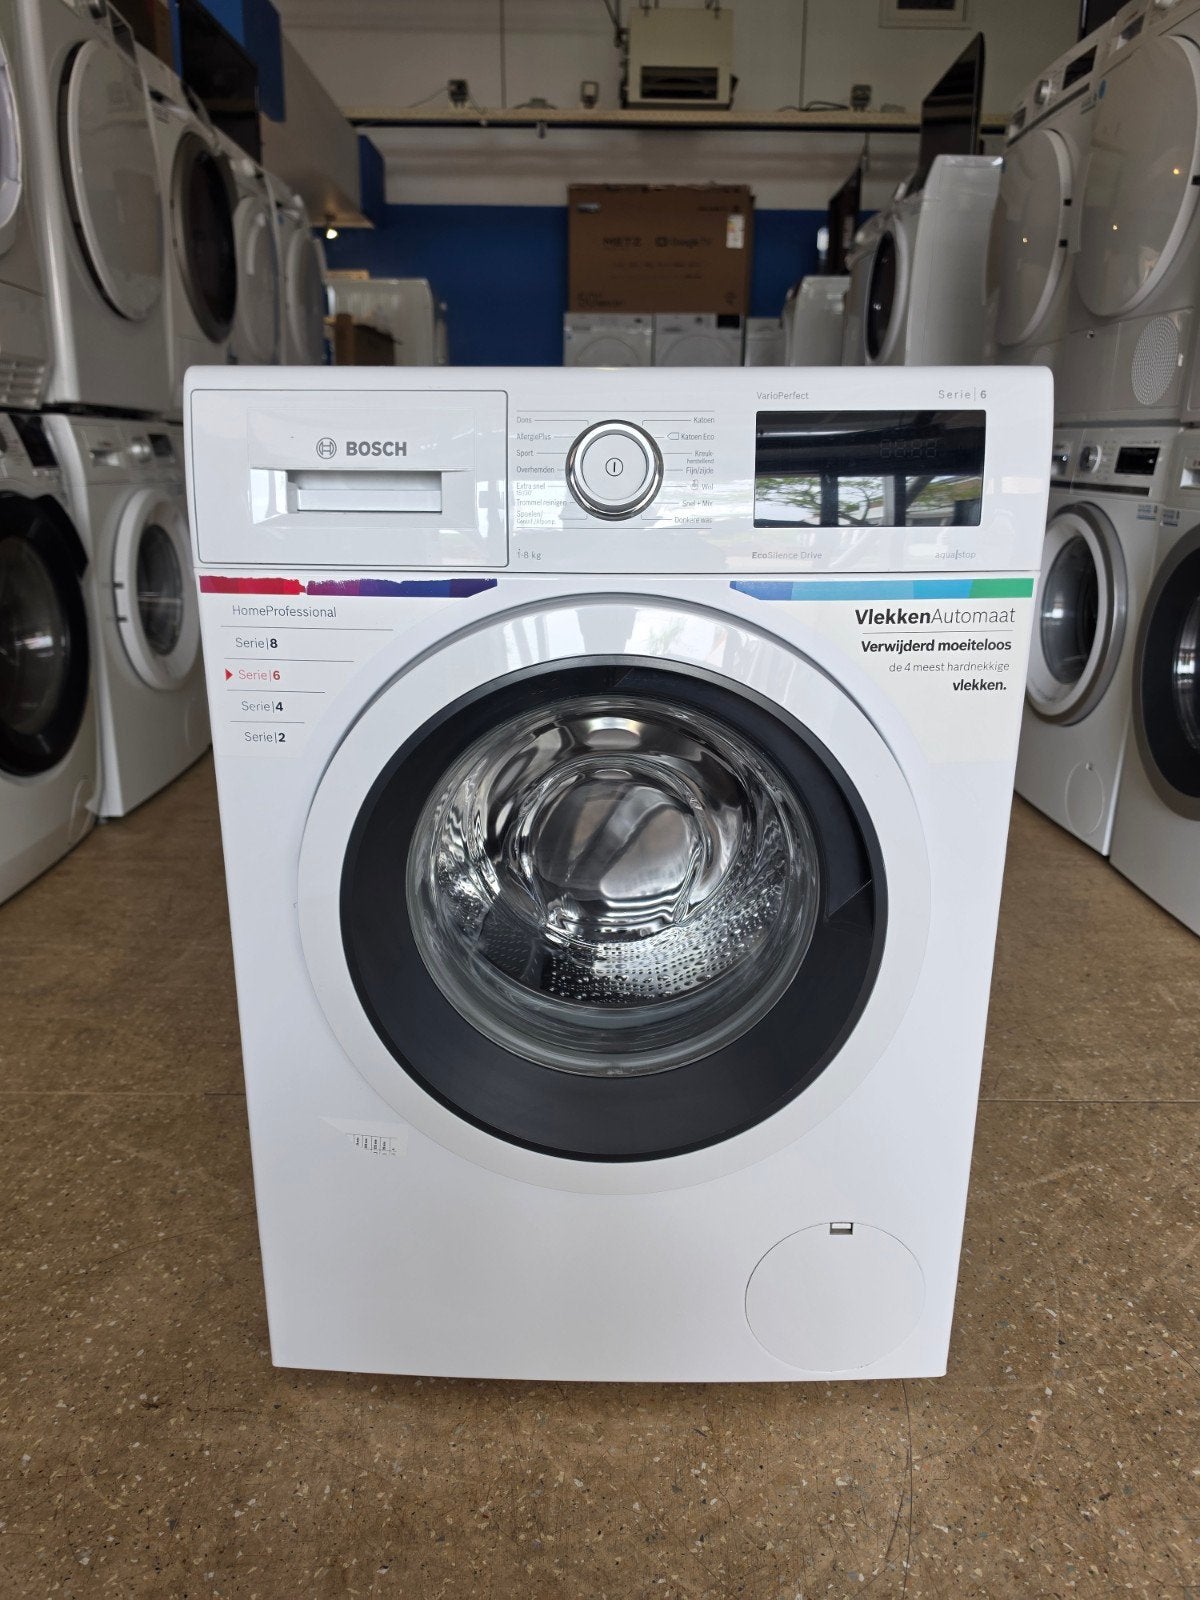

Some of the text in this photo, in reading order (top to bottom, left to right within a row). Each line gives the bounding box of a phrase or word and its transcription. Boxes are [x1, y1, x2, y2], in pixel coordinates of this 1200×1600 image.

[756, 391, 809, 400] VarioPerfect
[346, 441, 407, 456] BOSCH
[516, 449, 534, 457] Sport
[516, 465, 555, 473] Overhemden
[686, 466, 714, 475] Fijn/zijde
[516, 482, 546, 490] Extra snel
[531, 551, 542, 560] kg
[752, 551, 823, 560] EcoSilence Drive
[232, 605, 337, 618] HomeProfessional
[855, 608, 1016, 625] VlekkenAutomaat
[861, 638, 1012, 654] Verwijderd moeiteloos
[889, 661, 1010, 672] de 4 meest hardnekkige
[952, 679, 1007, 691] vlekken.
